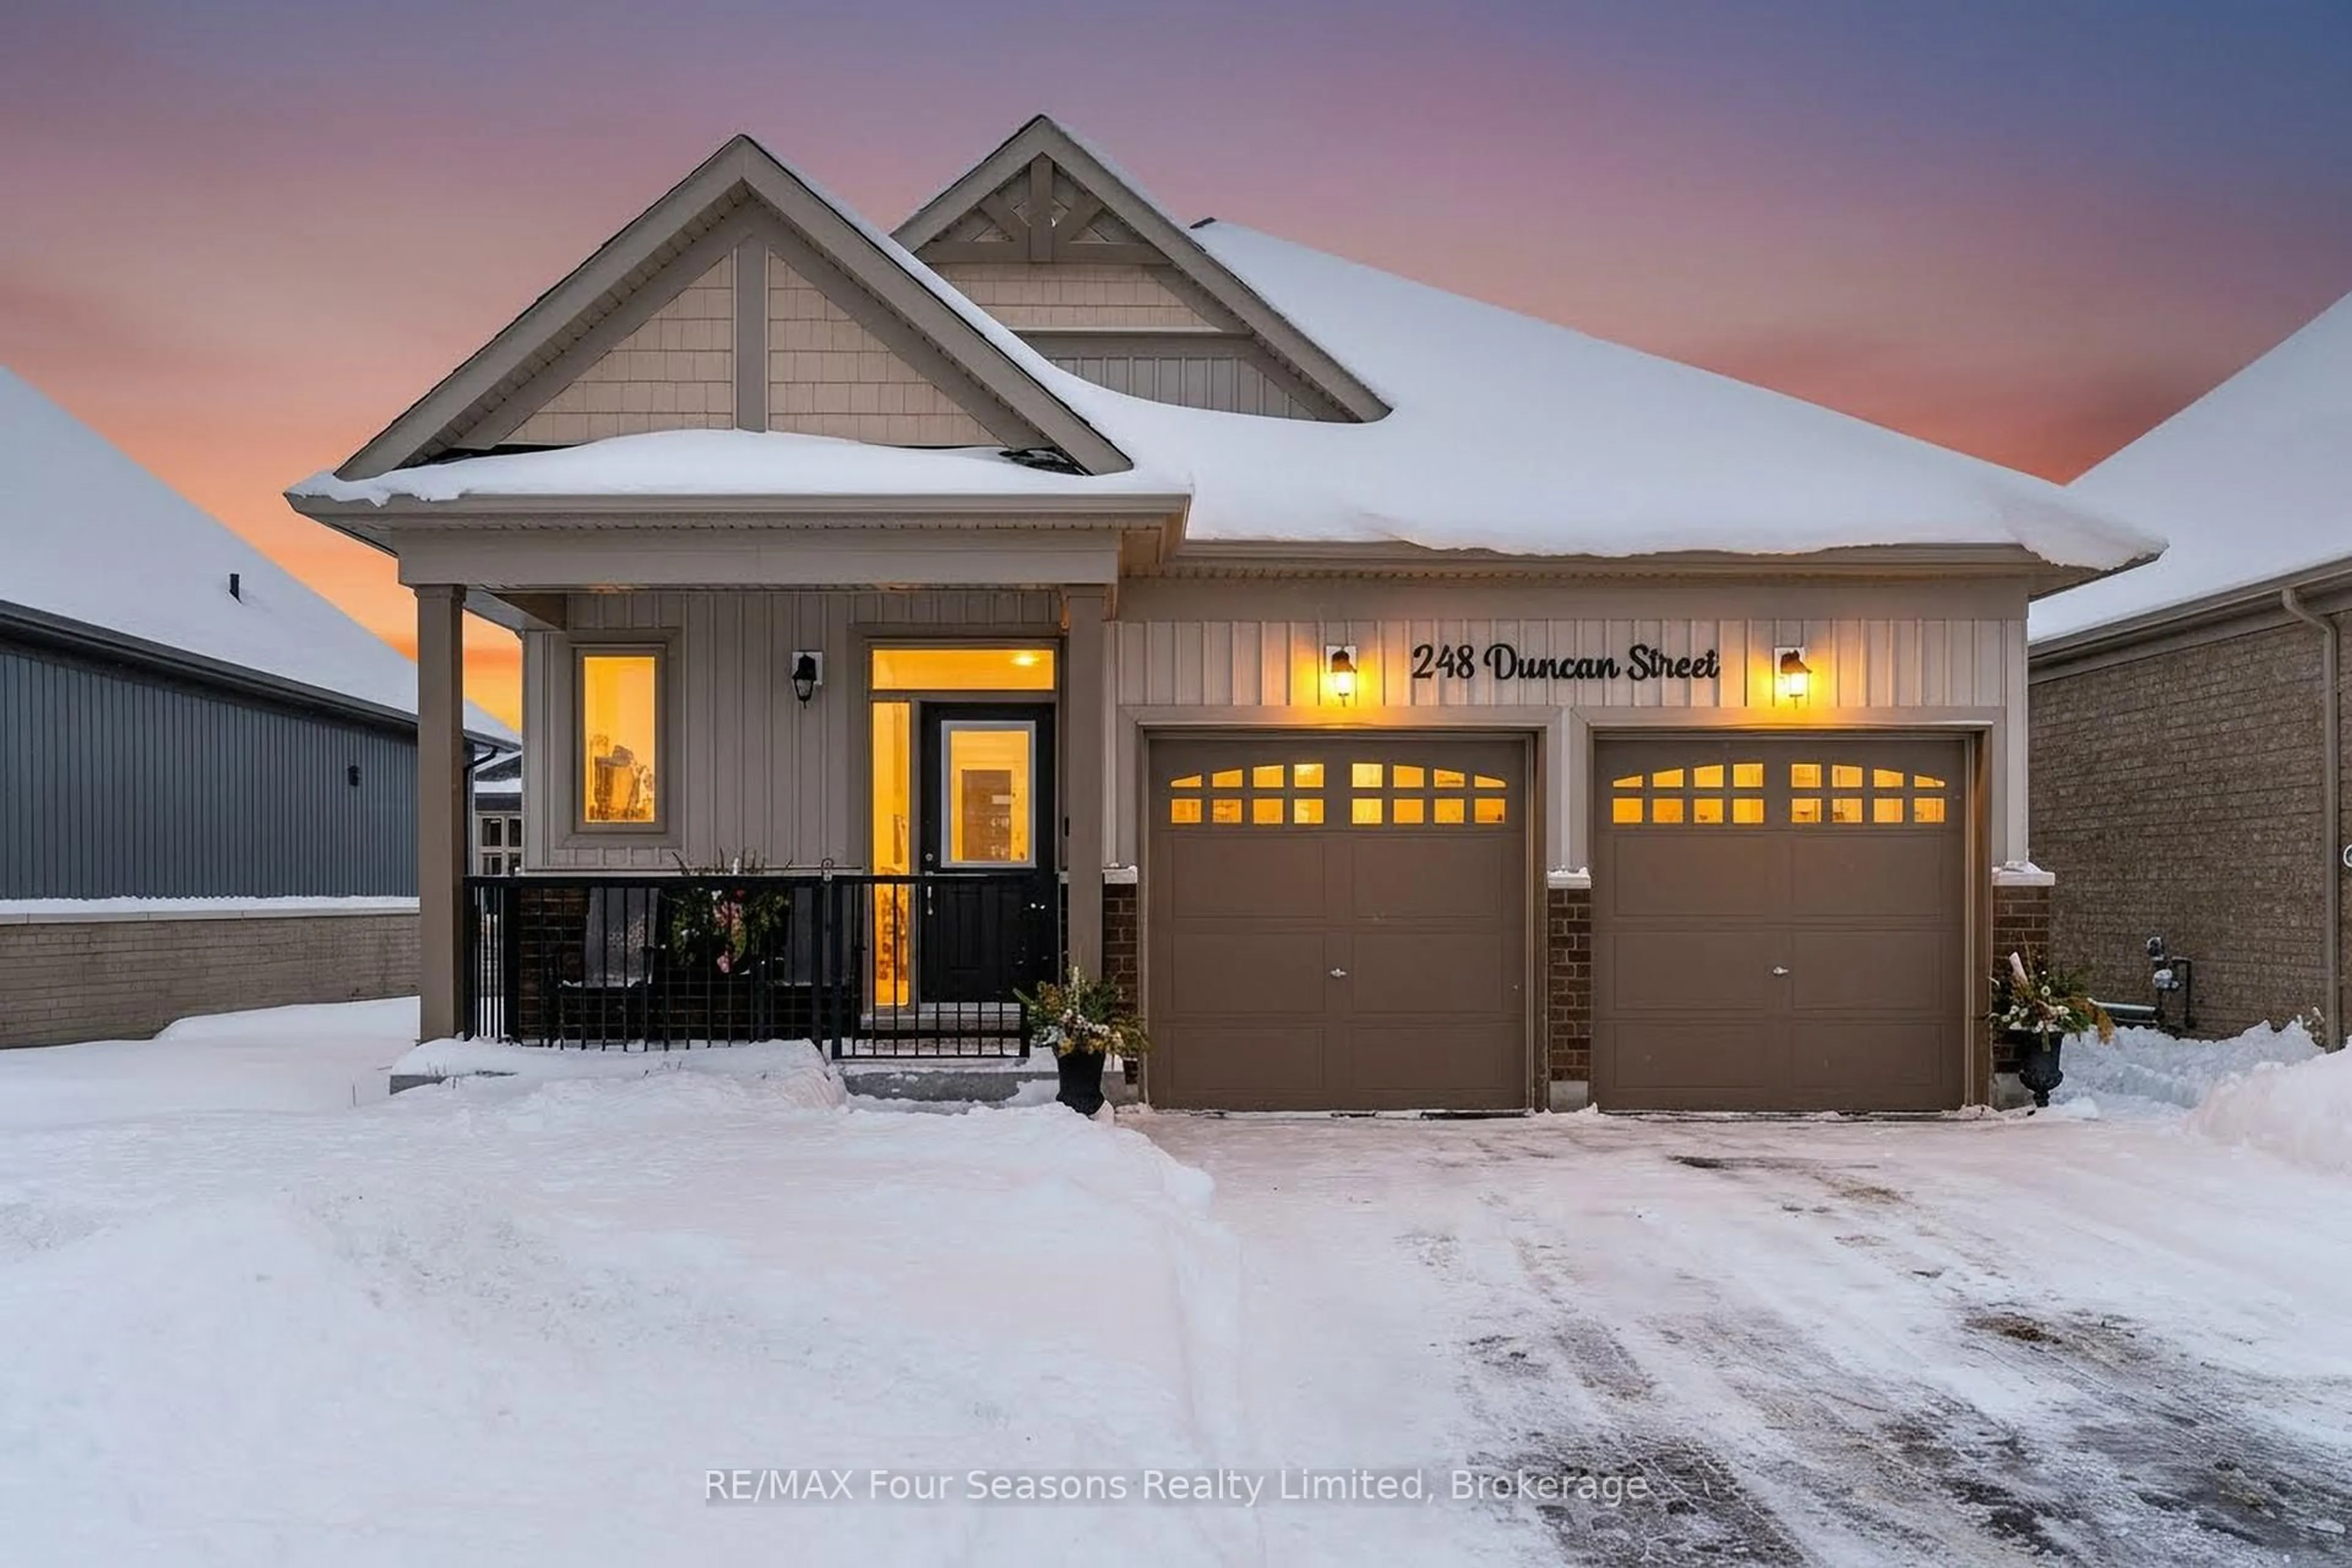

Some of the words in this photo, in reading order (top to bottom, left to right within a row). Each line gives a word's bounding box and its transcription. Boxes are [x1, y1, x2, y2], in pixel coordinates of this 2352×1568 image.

[1412, 644, 1475, 679] 248
[1483, 643, 1621, 680] Duncan
[1627, 644, 1720, 681] Street
